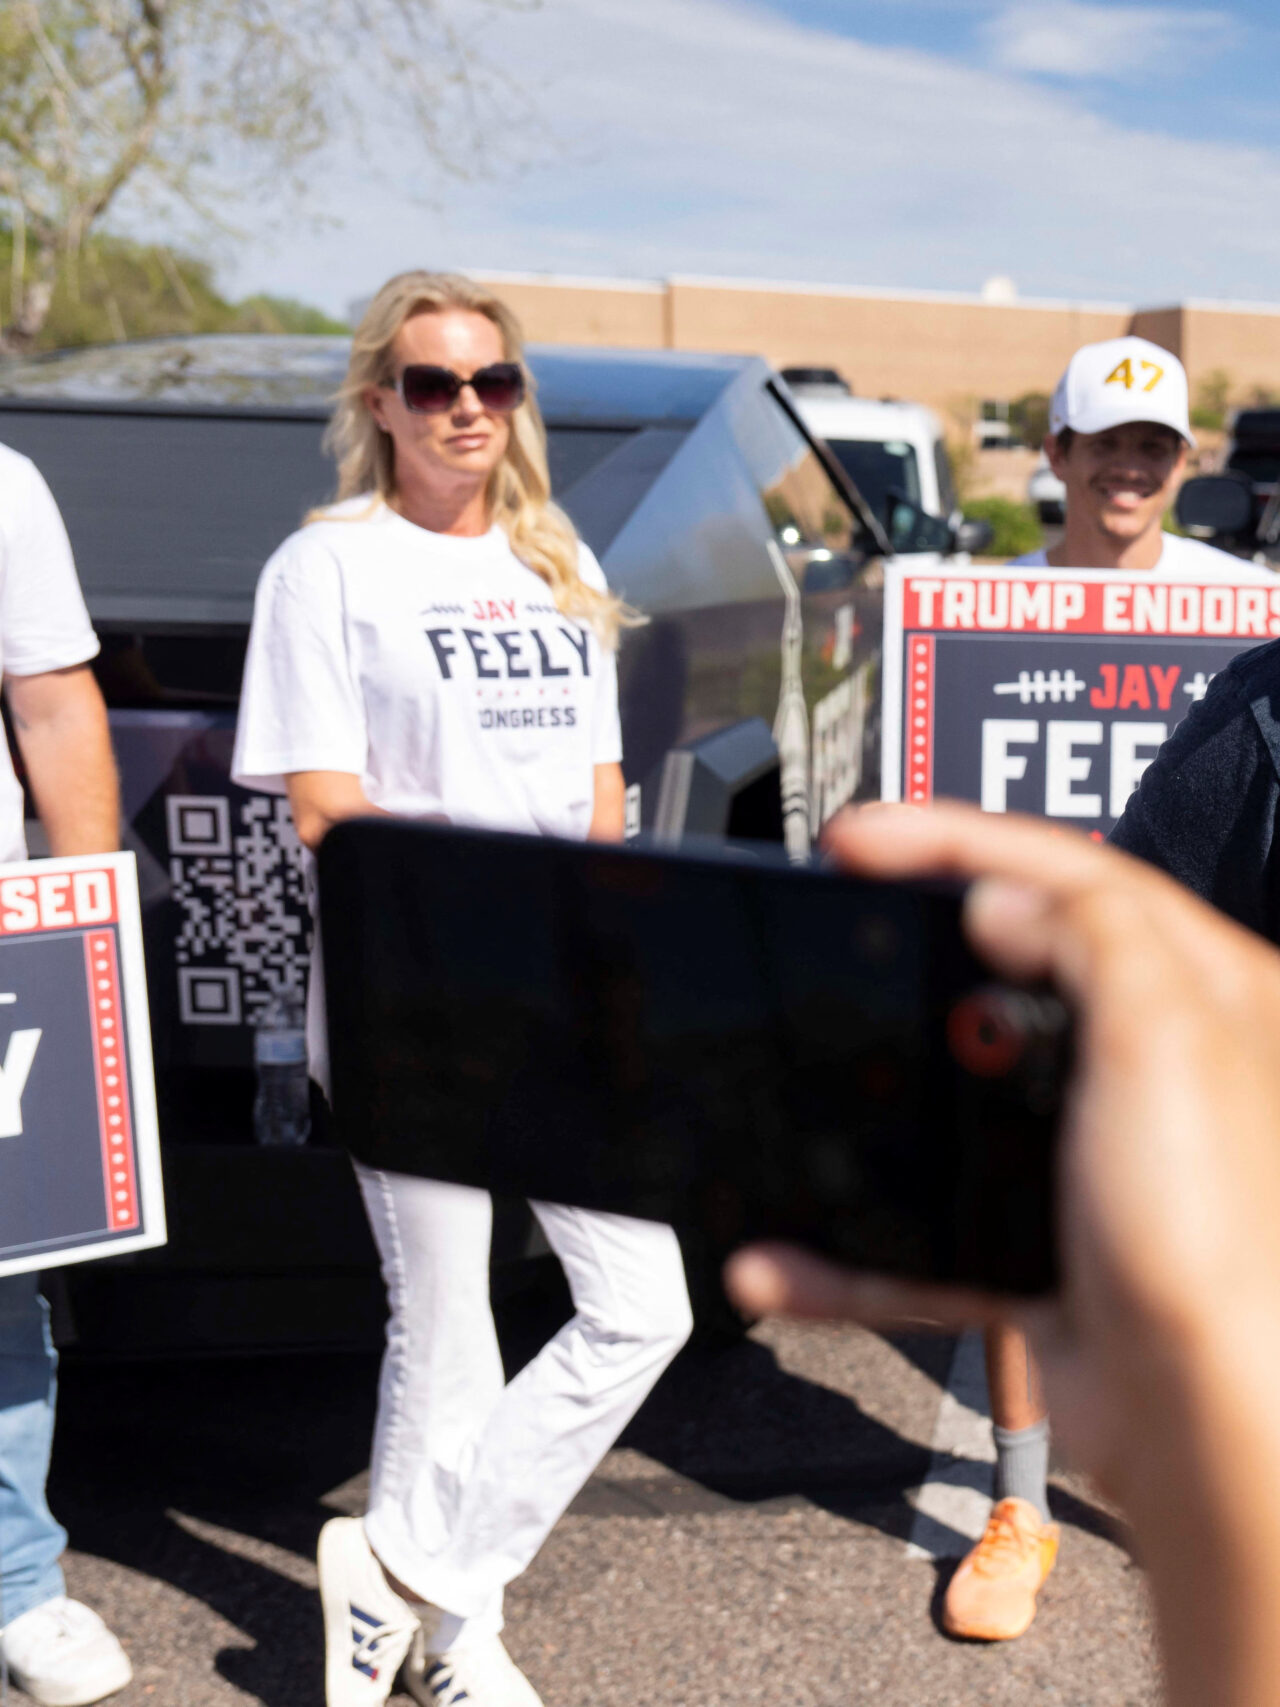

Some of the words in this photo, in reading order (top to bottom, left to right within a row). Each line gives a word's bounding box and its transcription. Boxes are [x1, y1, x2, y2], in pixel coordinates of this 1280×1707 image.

[1105, 357, 1164, 392] 47
[473, 600, 516, 620] JAY
[910, 579, 1085, 630] TRUMP
[425, 628, 592, 680] FEELY
[1090, 664, 1182, 710] JAY
[479, 706, 577, 729] ONGRESS
